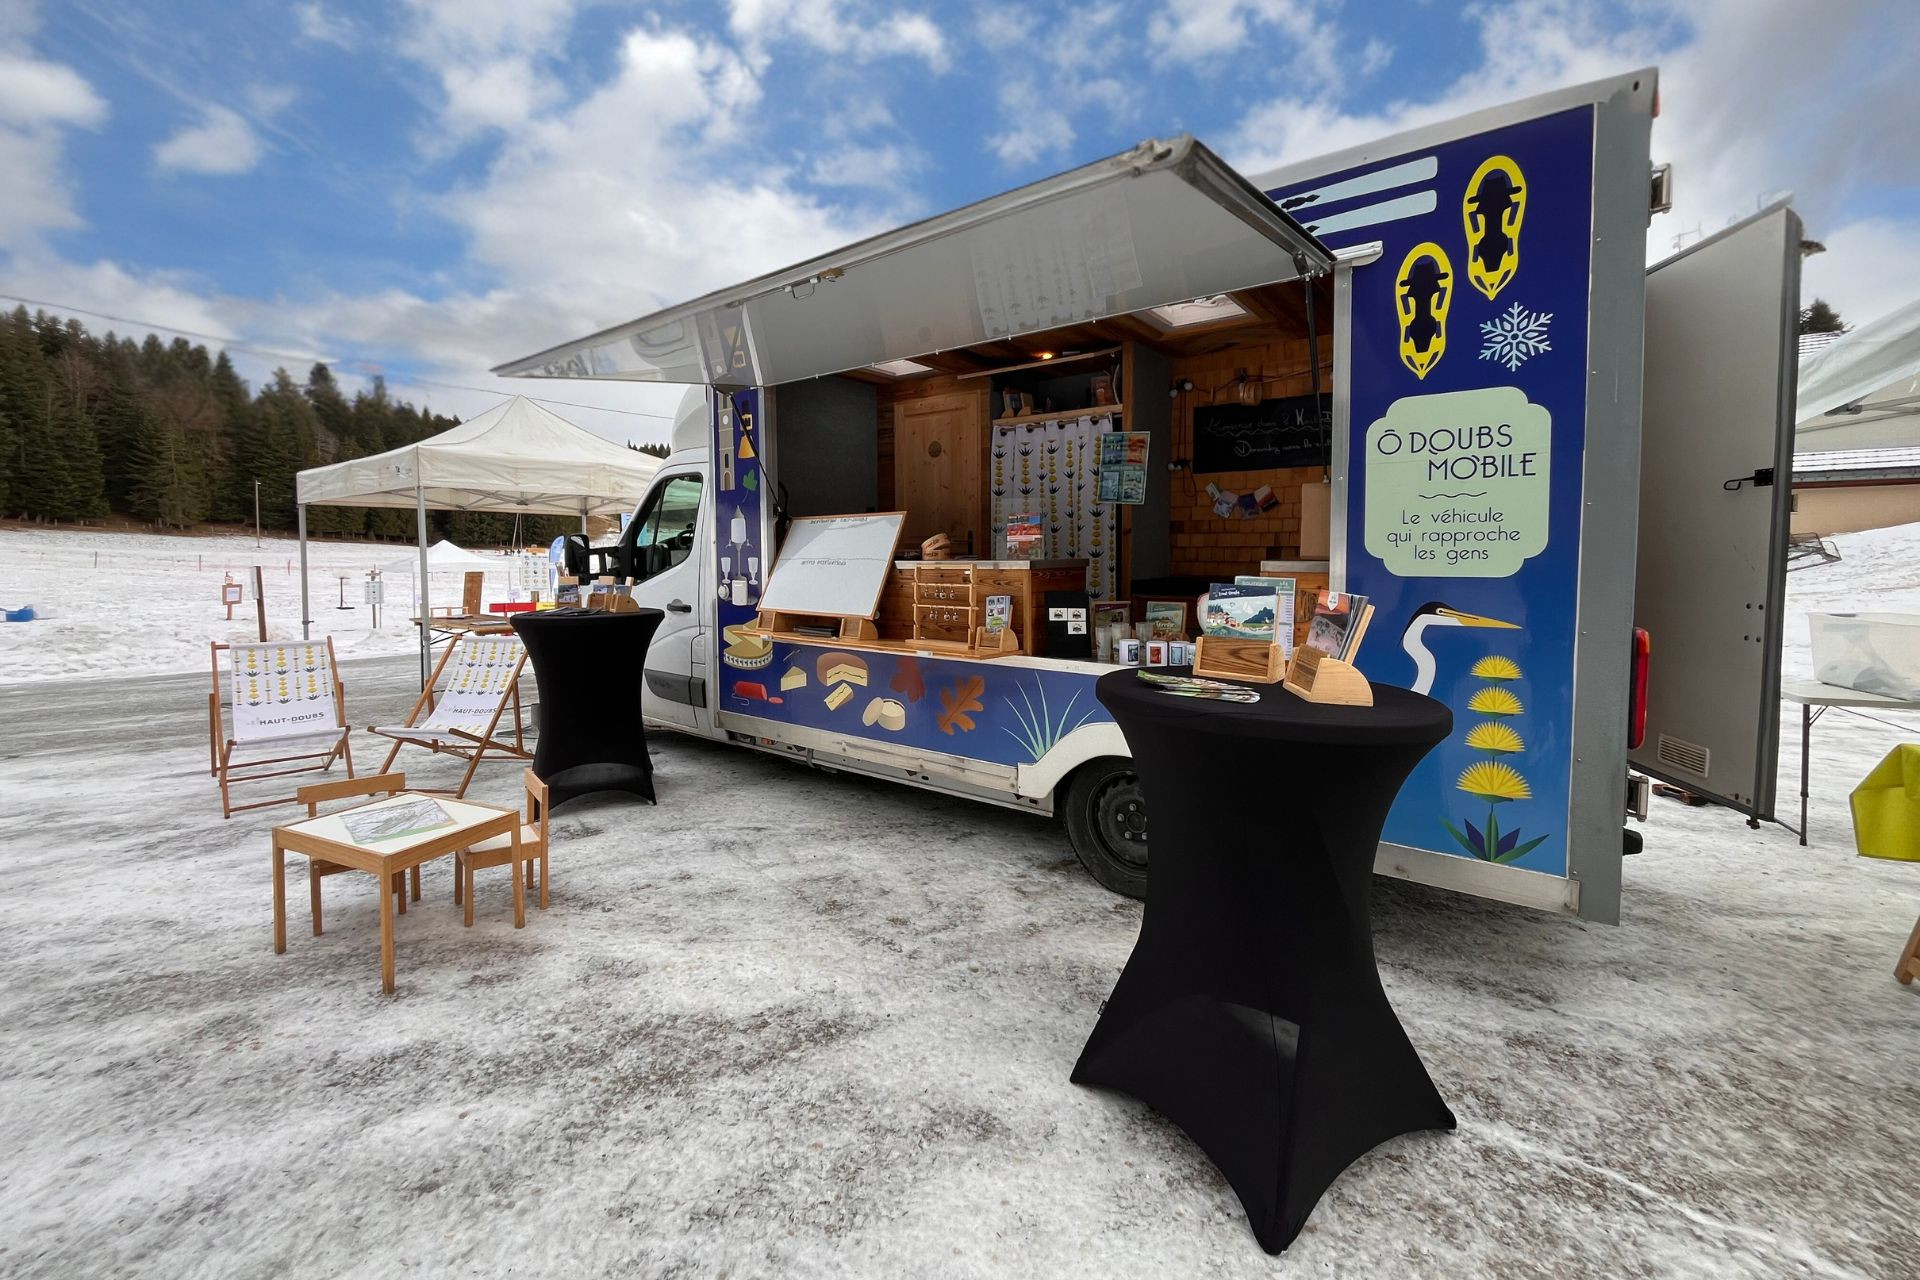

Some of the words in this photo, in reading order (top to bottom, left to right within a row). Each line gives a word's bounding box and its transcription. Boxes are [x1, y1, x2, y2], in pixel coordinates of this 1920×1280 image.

[1408, 424, 1513, 455] DOUBS
[1402, 509, 1421, 524] Le
[1431, 507, 1504, 524] véhicule
[1387, 529, 1412, 548] qui
[1421, 525, 1521, 548] rapproche
[1414, 545, 1436, 560] les
[1446, 549, 1489, 565] gens
[259, 711, 326, 726] HAUT-DOUBS
